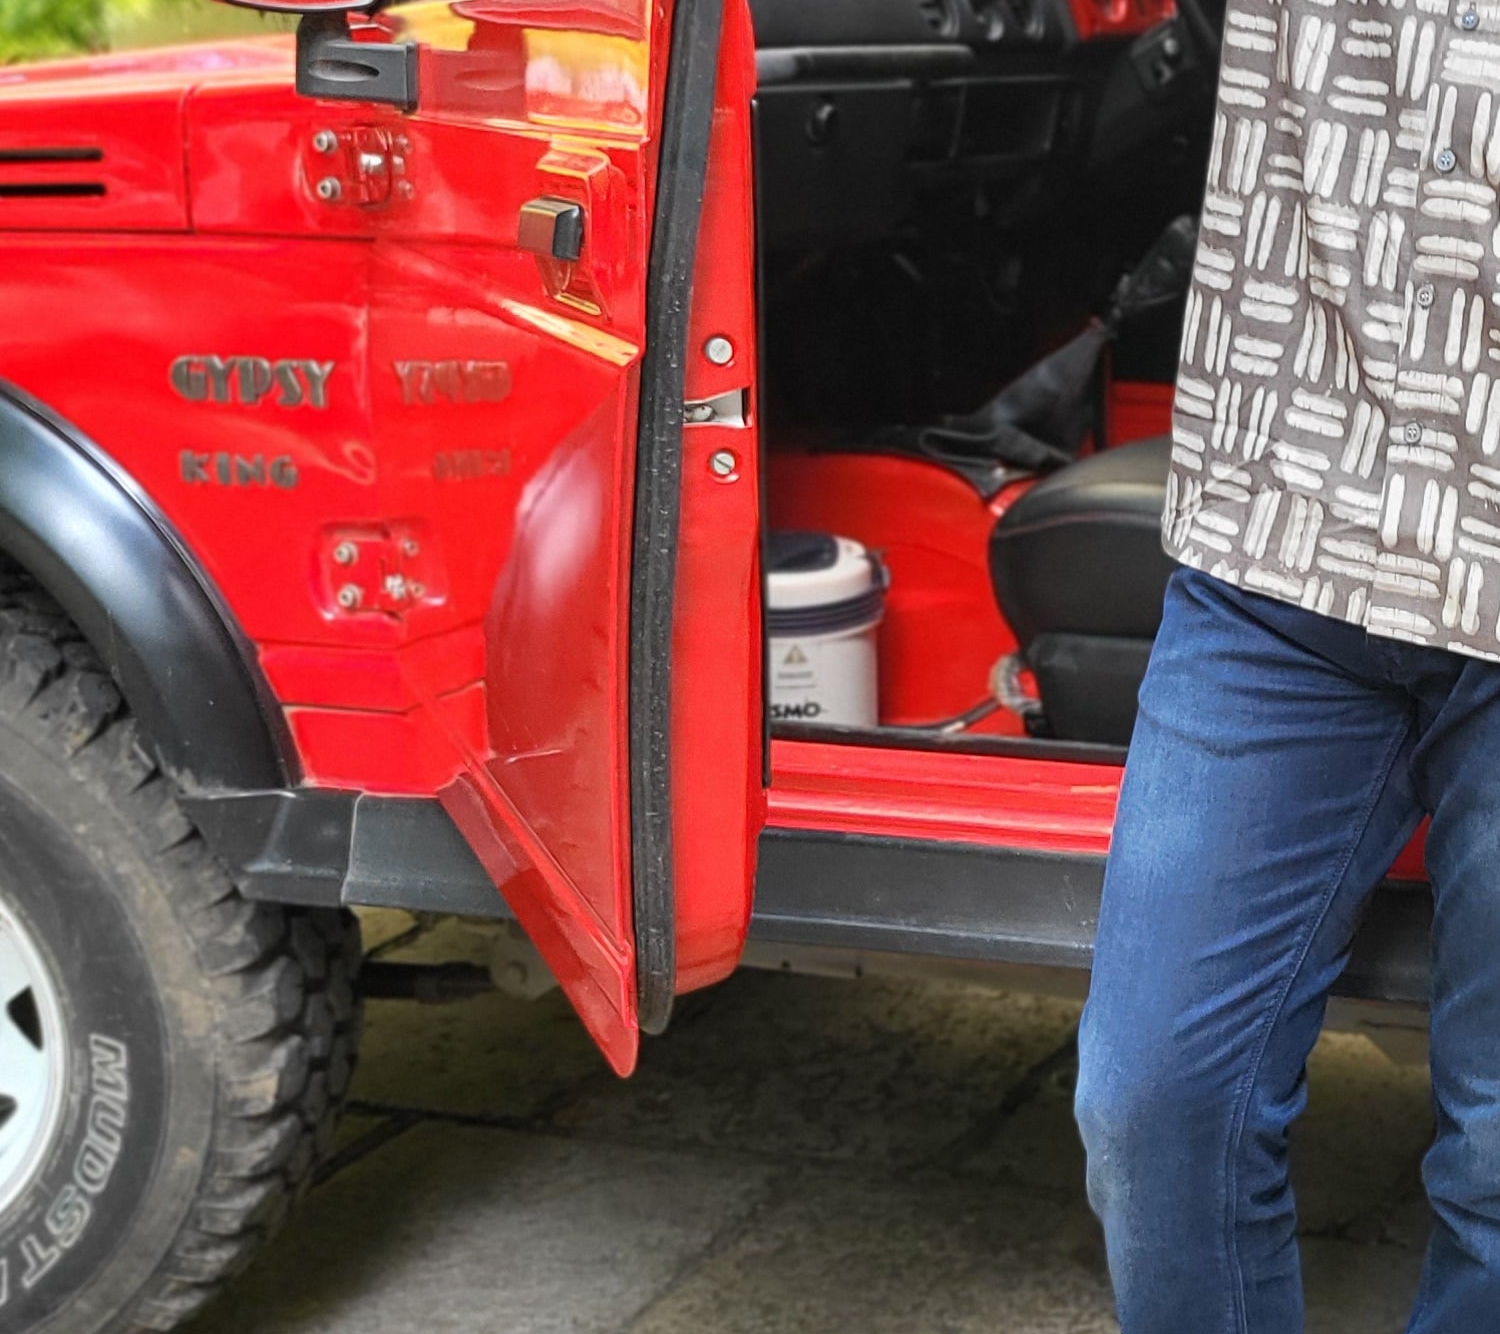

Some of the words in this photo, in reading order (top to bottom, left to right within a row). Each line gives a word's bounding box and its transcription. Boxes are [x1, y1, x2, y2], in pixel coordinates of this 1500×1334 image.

[170, 354, 335, 408] GYPSY
[179, 450, 298, 489] KING
[0, 1033, 128, 1306] MUDST
